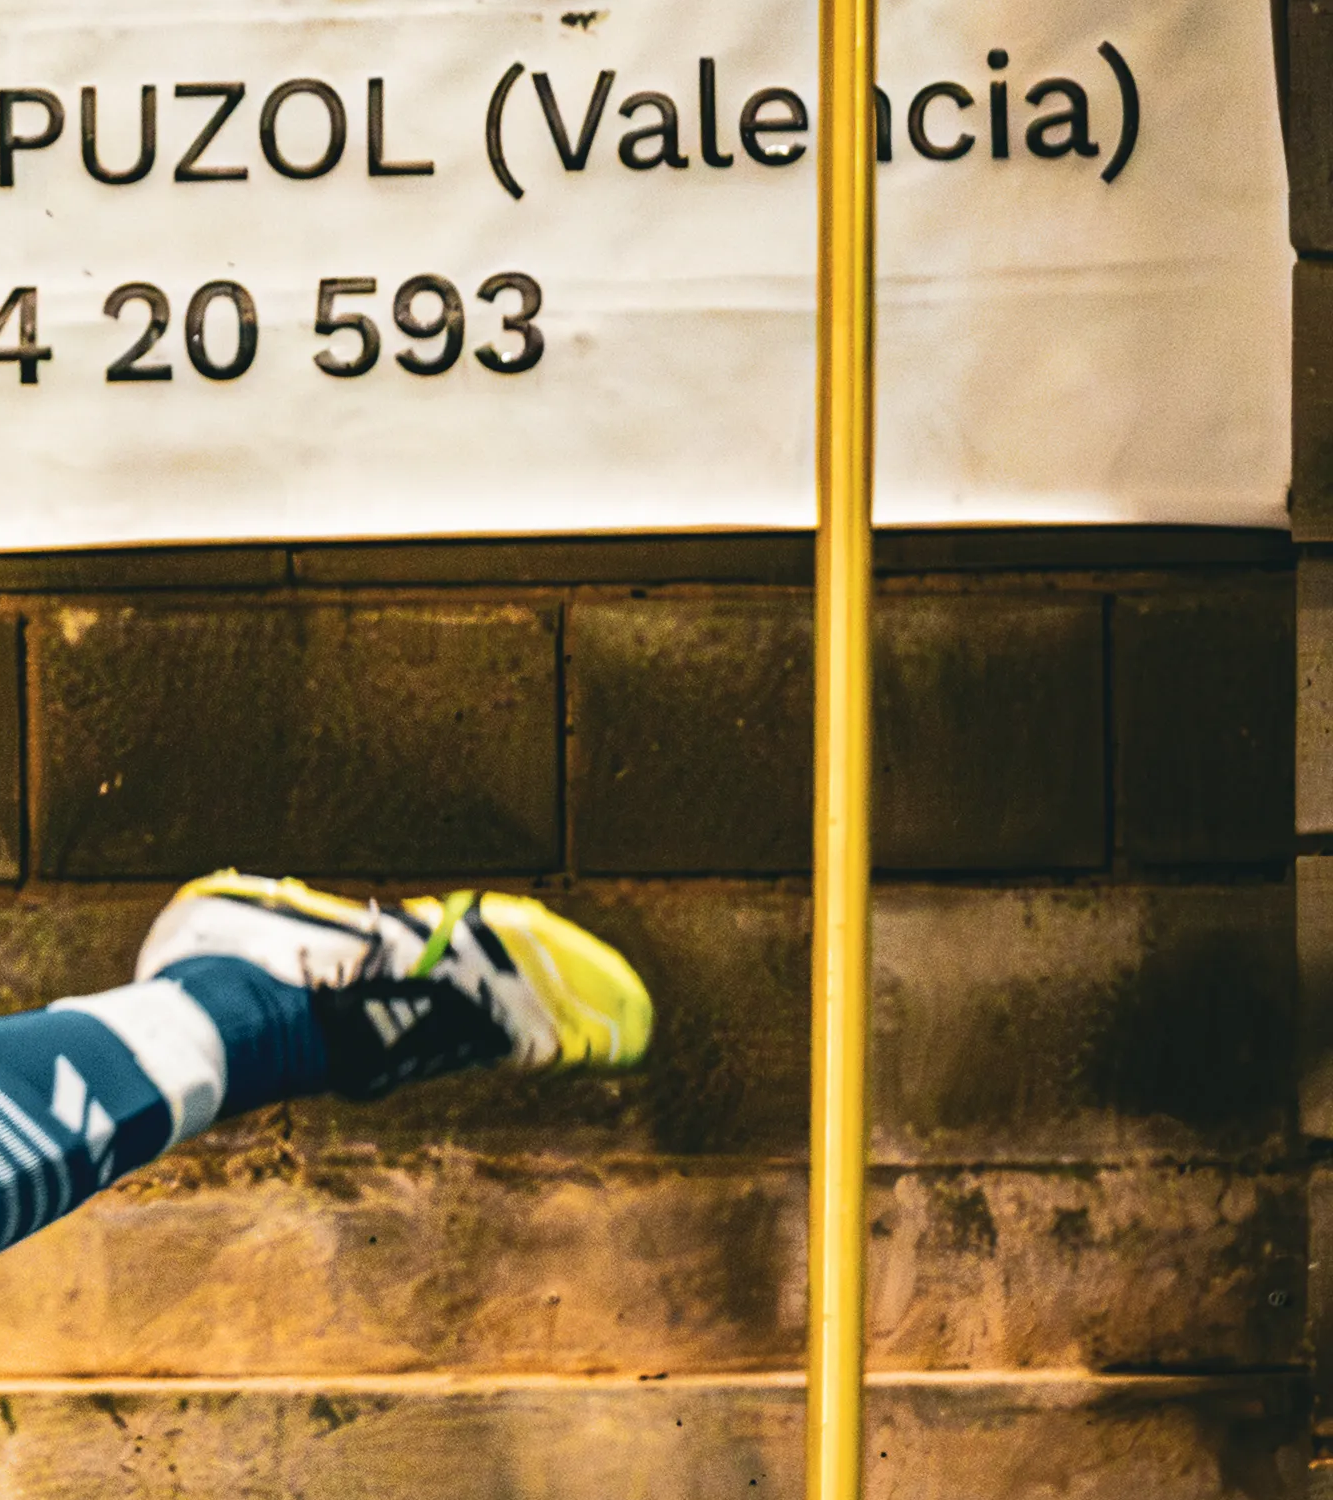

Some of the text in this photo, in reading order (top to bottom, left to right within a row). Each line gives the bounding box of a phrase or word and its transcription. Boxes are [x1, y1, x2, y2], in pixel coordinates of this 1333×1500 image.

[485, 41, 1141, 200] (Valecia)
[102, 280, 260, 383] 20
[312, 271, 546, 379] 593
